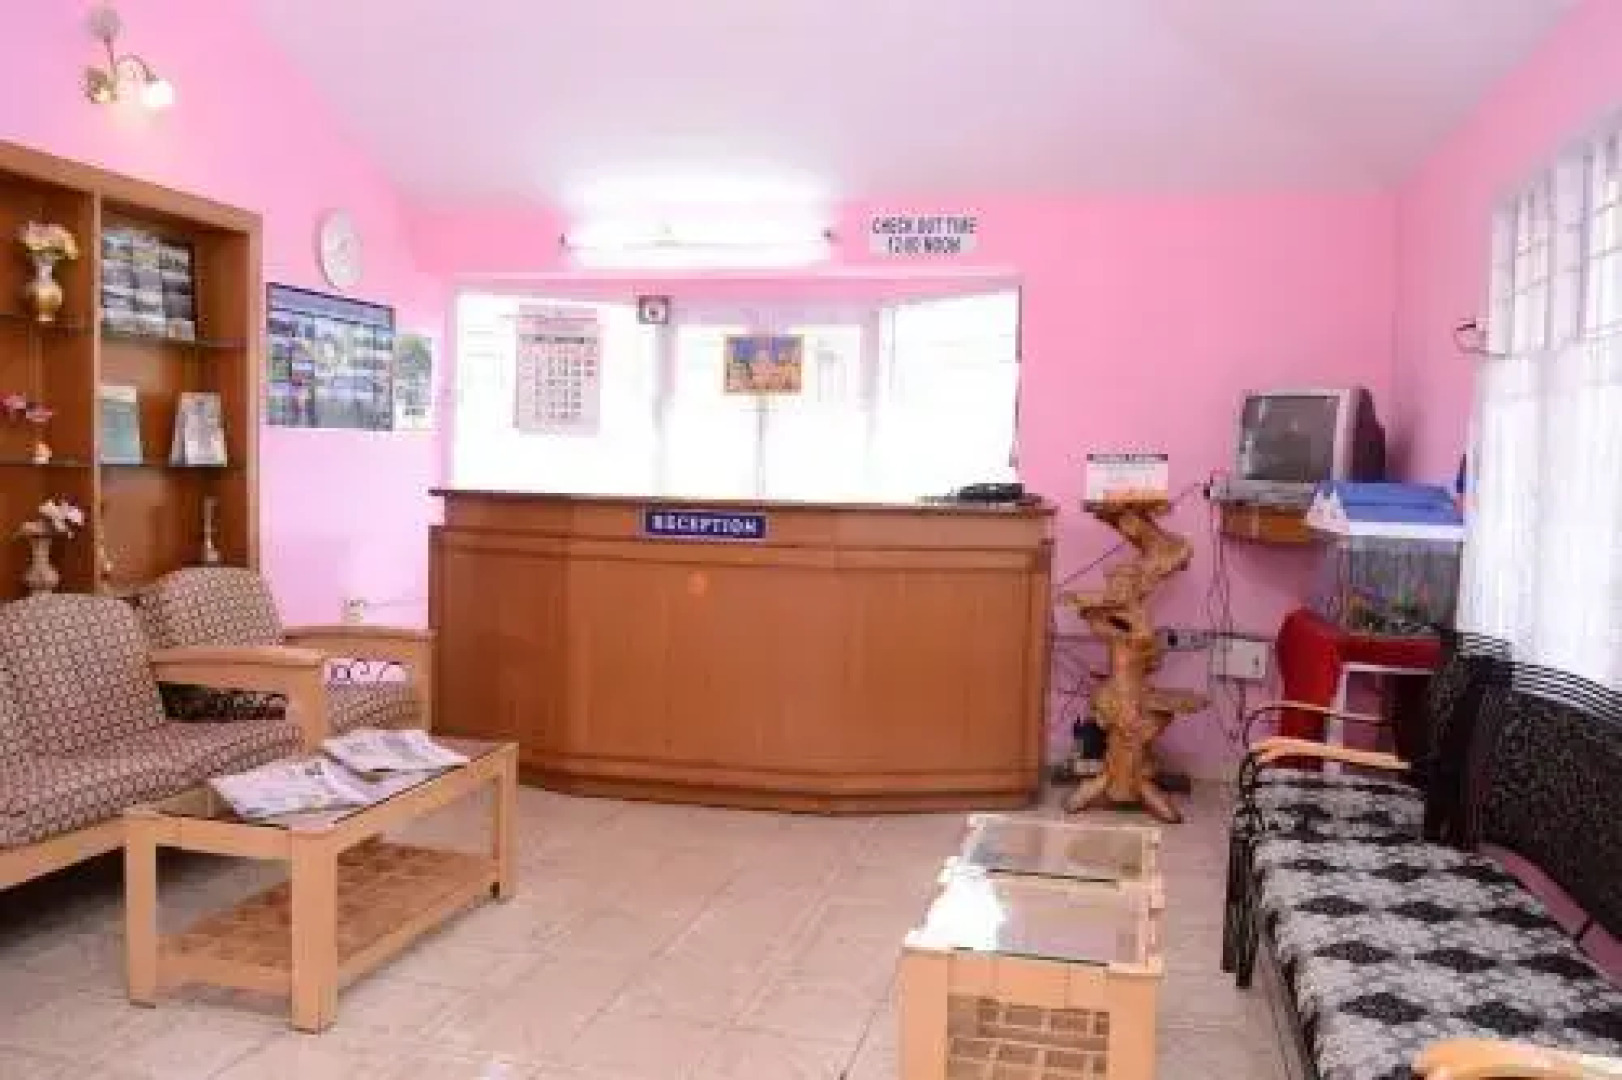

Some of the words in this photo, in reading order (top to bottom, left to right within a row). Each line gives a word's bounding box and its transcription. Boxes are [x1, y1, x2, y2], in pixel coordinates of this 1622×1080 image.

[872, 217, 912, 234] CHECK
[918, 217, 942, 234] OUT
[947, 217, 978, 234] TIME
[652, 515, 757, 535] RECEPTION
